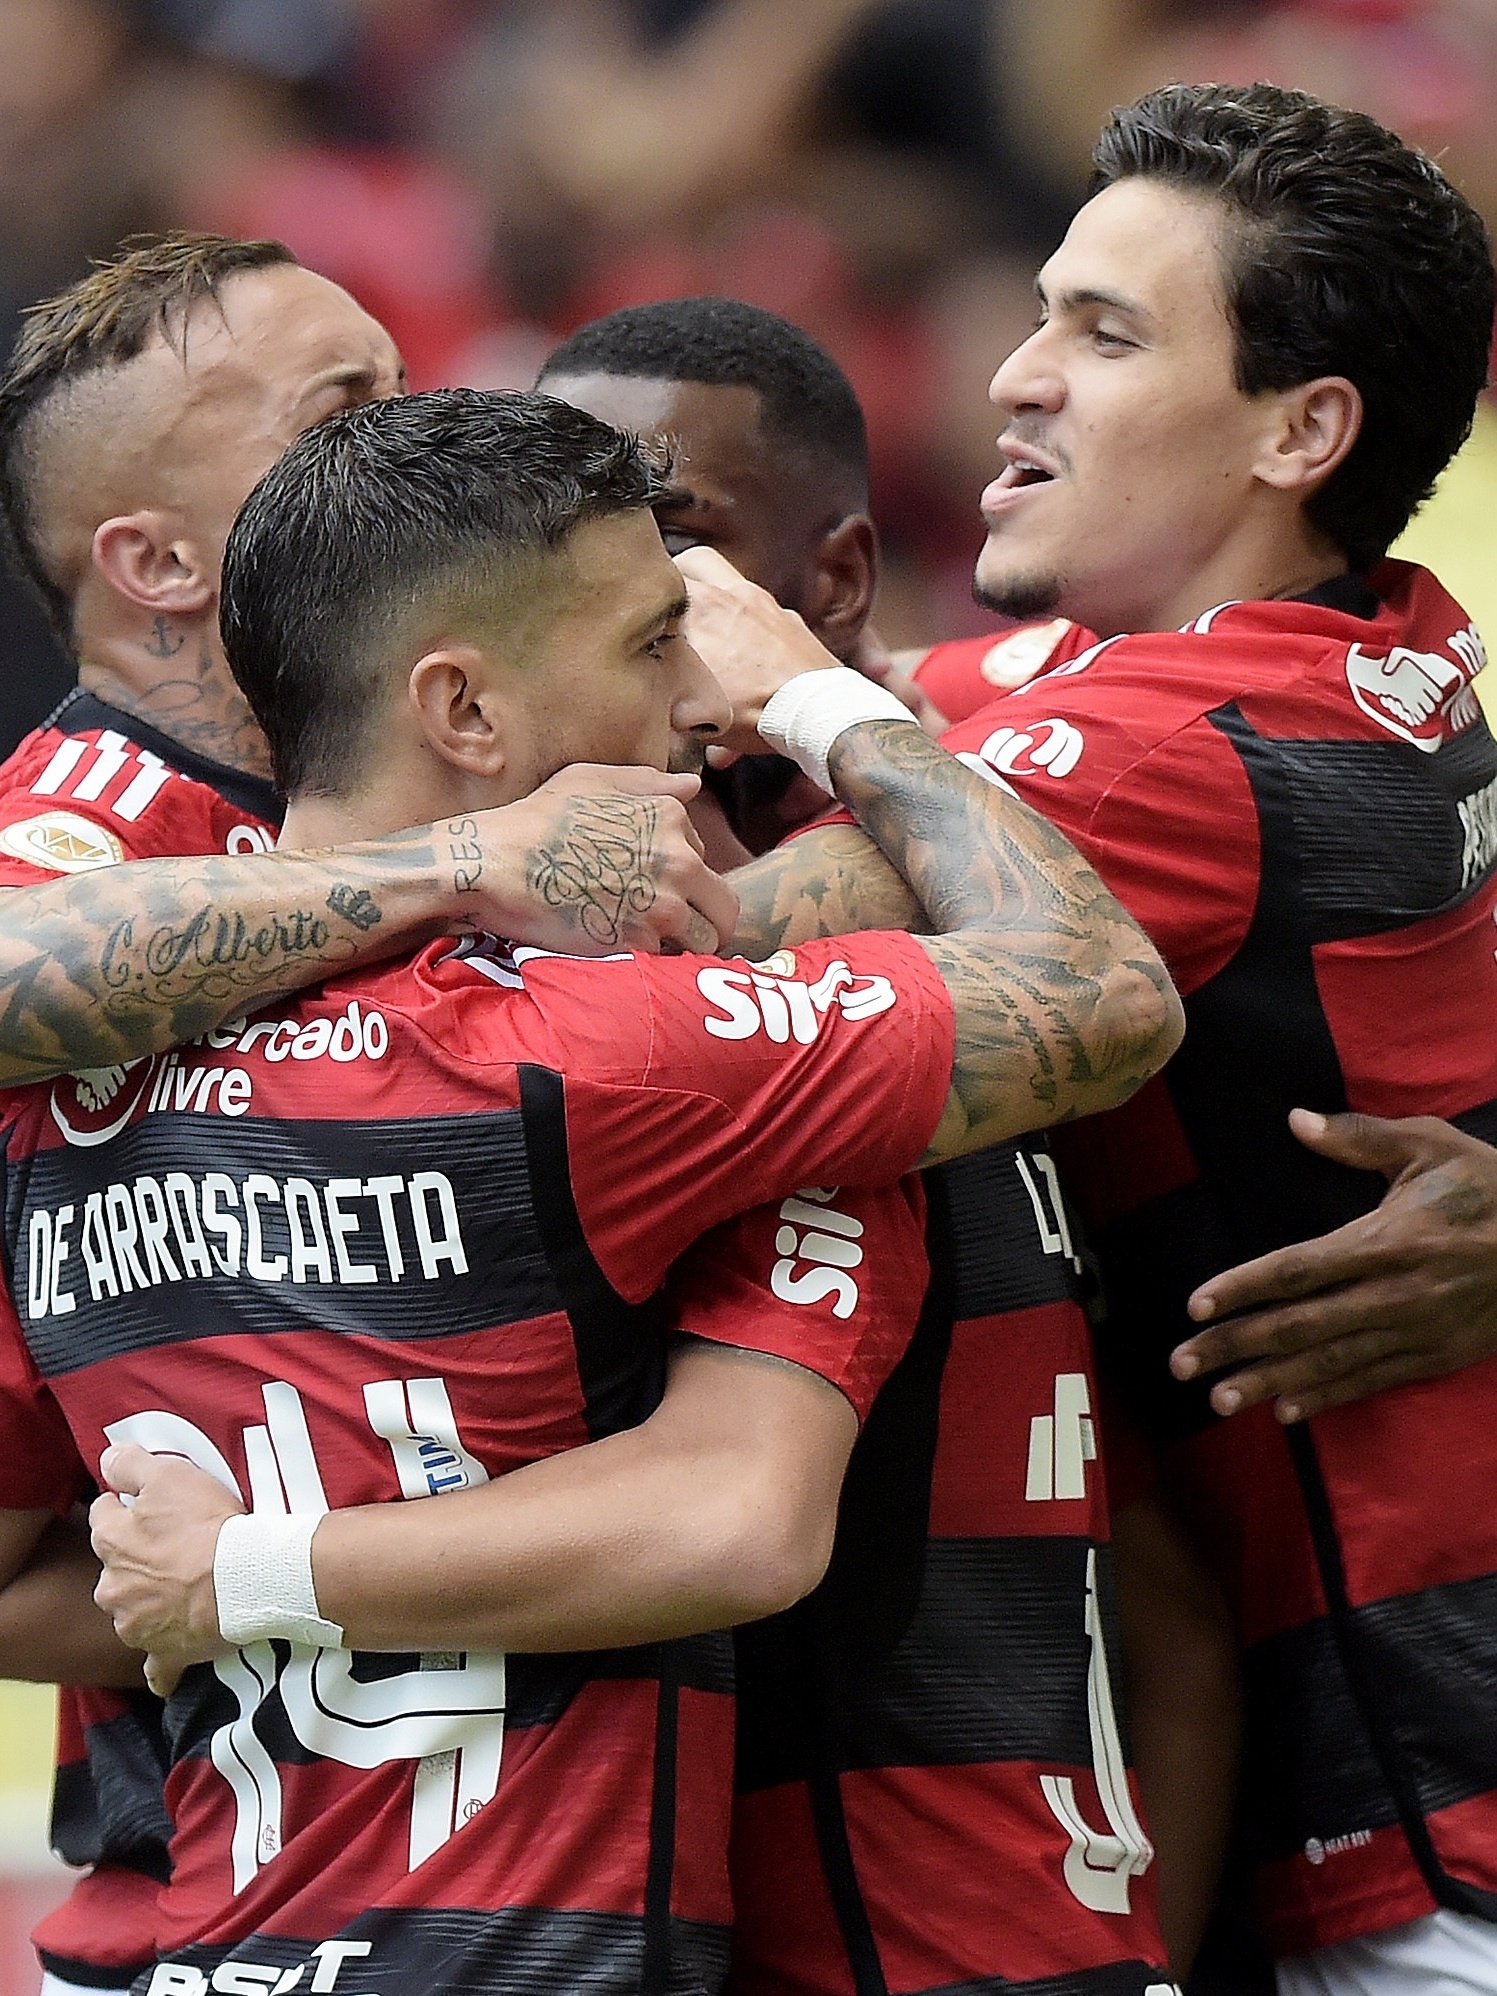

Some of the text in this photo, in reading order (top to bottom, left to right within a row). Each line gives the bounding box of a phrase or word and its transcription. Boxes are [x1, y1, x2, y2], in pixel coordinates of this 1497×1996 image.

[147, 903, 330, 976] Alberto
[190, 1001, 389, 1062] ercado
[148, 1053, 252, 1117] livre
[29, 1171, 469, 1319] DE ARRASCAETA
